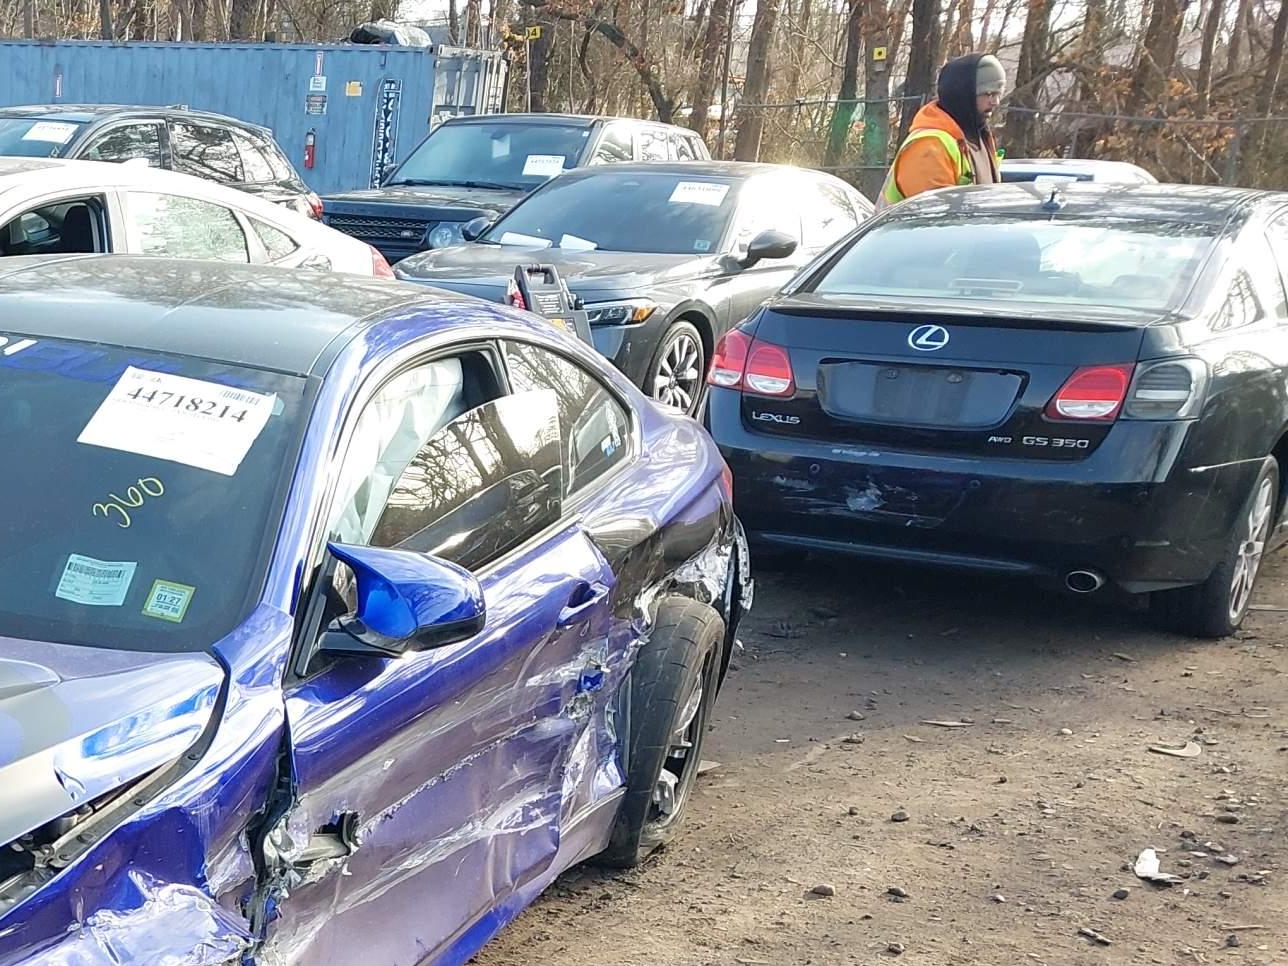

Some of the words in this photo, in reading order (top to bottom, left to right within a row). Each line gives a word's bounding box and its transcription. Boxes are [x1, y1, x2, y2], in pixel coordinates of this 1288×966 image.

[127, 386, 248, 423] 44718214
[751, 411, 801, 425] LEXUS
[987, 435, 1013, 444] AWD
[1022, 436, 1049, 446] GS
[1051, 438, 1090, 448] 350
[92, 477, 164, 528] 360
